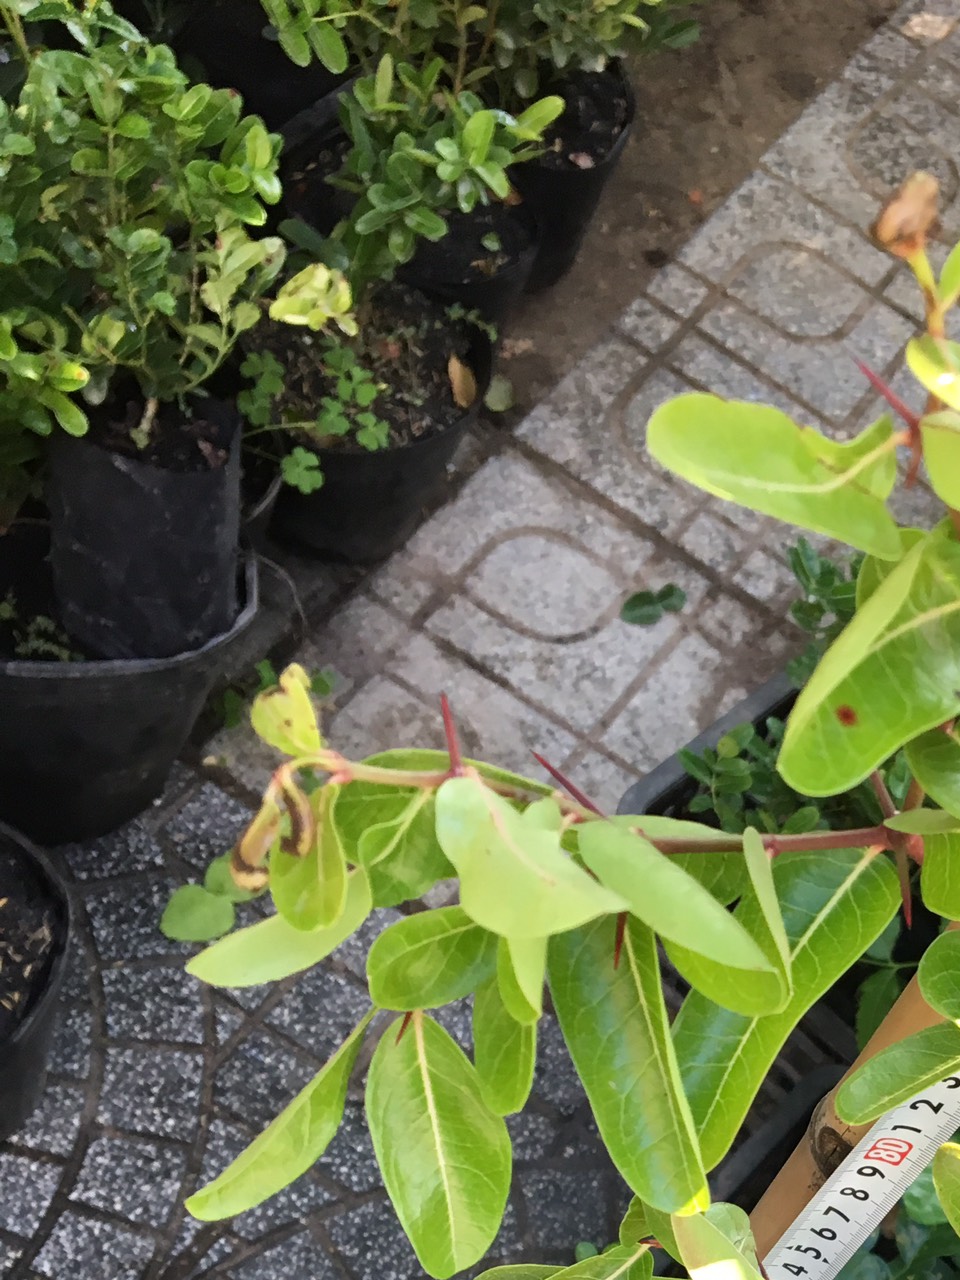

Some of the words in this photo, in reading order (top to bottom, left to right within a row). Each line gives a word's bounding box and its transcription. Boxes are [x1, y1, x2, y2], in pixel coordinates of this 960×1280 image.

[910, 1100, 944, 1114] 2
[891, 1125, 922, 1133] 1
[865, 1139, 912, 1165] 80
[857, 1166, 885, 1179] 9
[840, 1187, 869, 1201] 8
[823, 1206, 850, 1223] 7
[810, 1227, 837, 1241] 6
[794, 1245, 822, 1260] 5
[782, 1263, 808, 1276] 4
